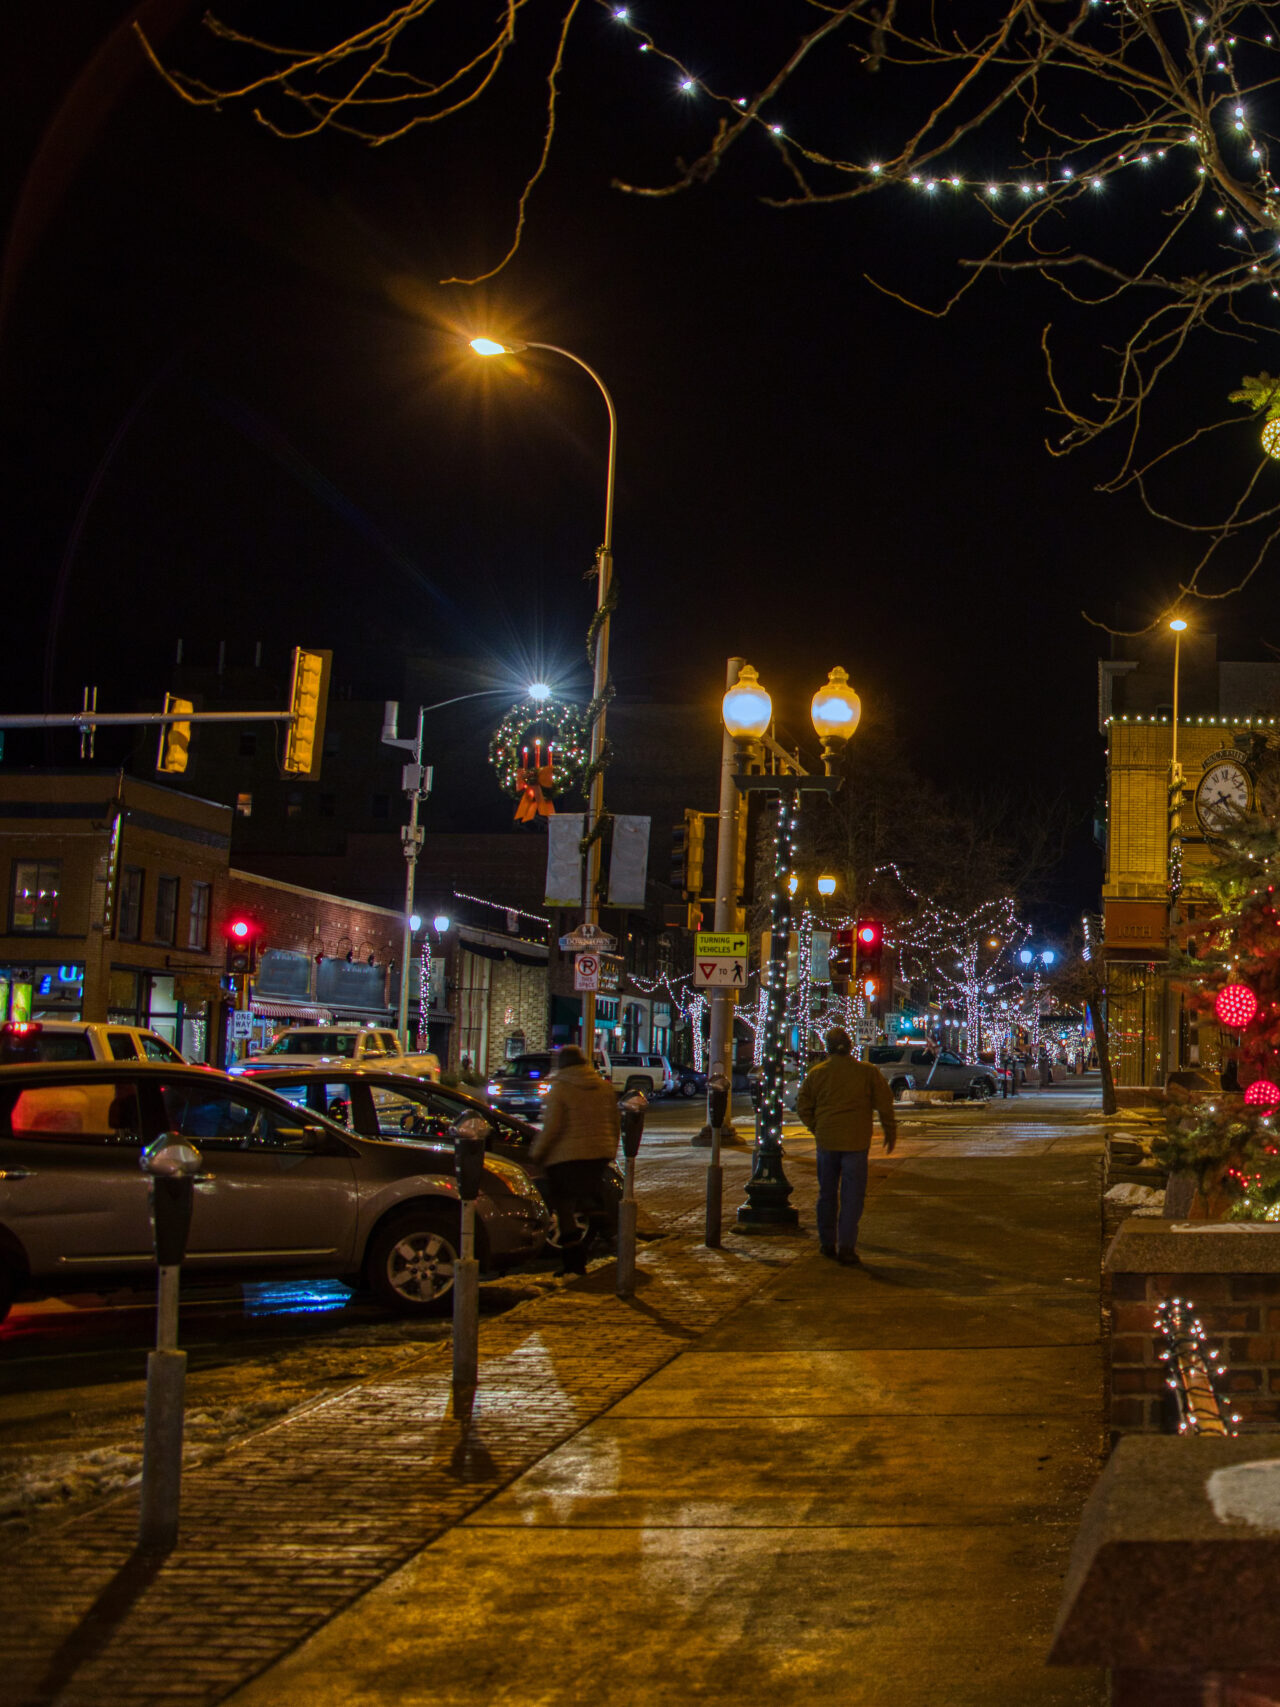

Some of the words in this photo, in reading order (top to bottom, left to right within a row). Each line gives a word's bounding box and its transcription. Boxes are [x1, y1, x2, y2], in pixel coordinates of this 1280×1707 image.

[567, 937, 610, 945] DOWNTOWN
[700, 936, 731, 944] TURNING
[699, 945, 731, 953] VEHICLES
